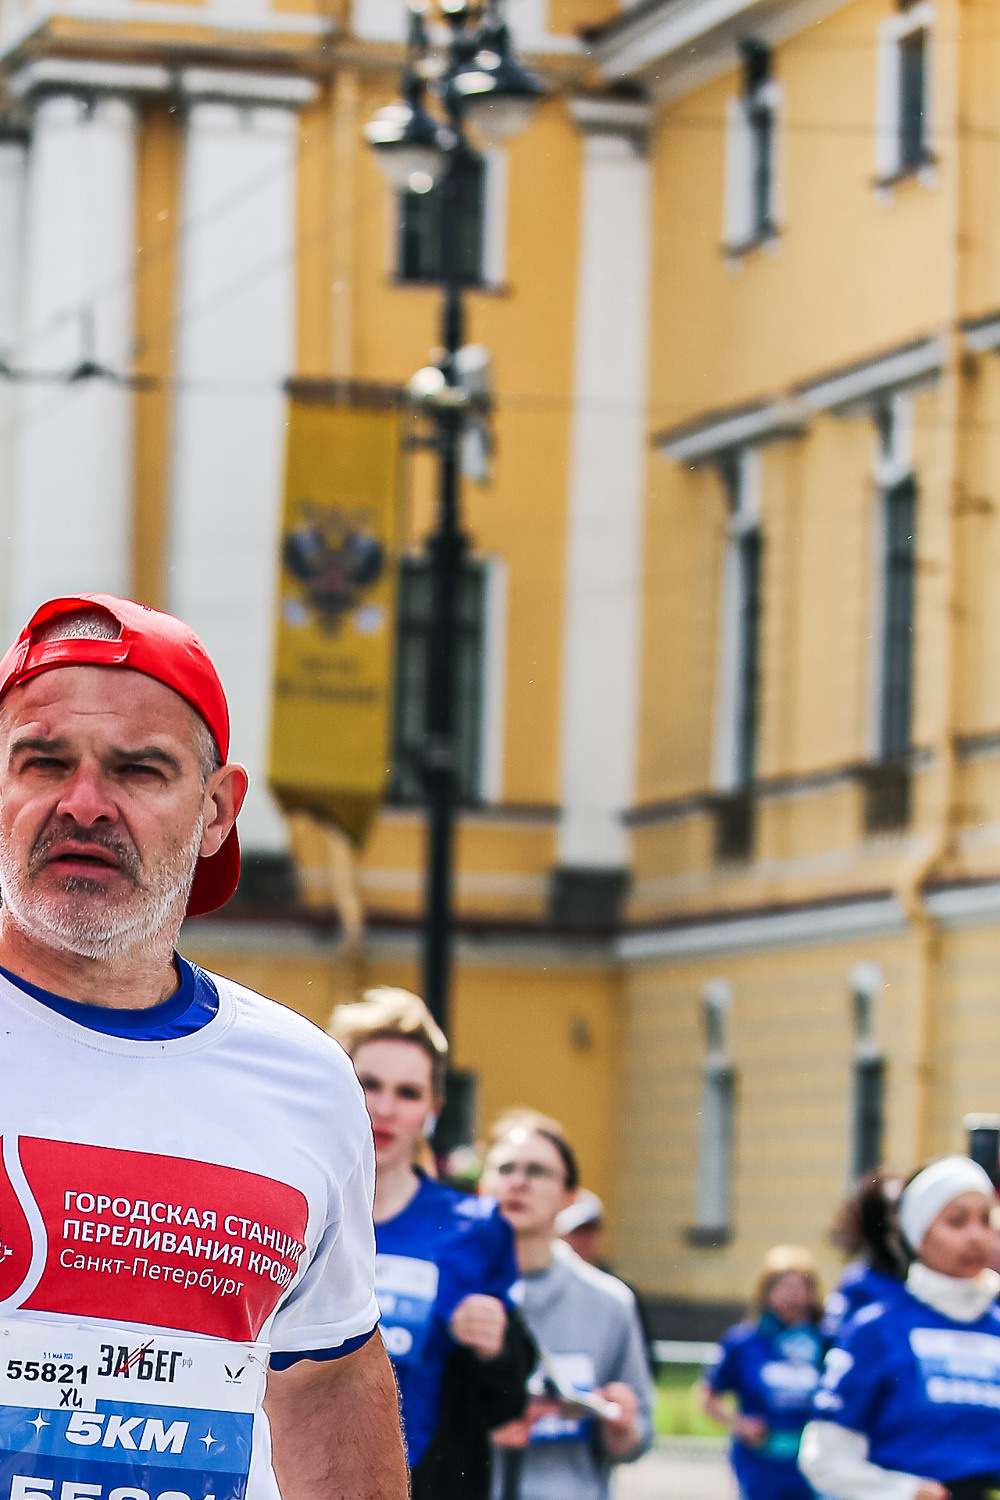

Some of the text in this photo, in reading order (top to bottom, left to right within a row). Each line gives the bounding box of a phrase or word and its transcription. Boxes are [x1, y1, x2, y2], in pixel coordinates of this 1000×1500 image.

[62, 1219, 293, 1289] ПЕРЕЛИВАНИЯ КРОВИ
[63, 1189, 303, 1264] ГОРОДСКАЯ СТАНЦИЯ
[59, 1247, 245, 1298] Санкт-Петербург
[6, 1359, 89, 1384] 55821
